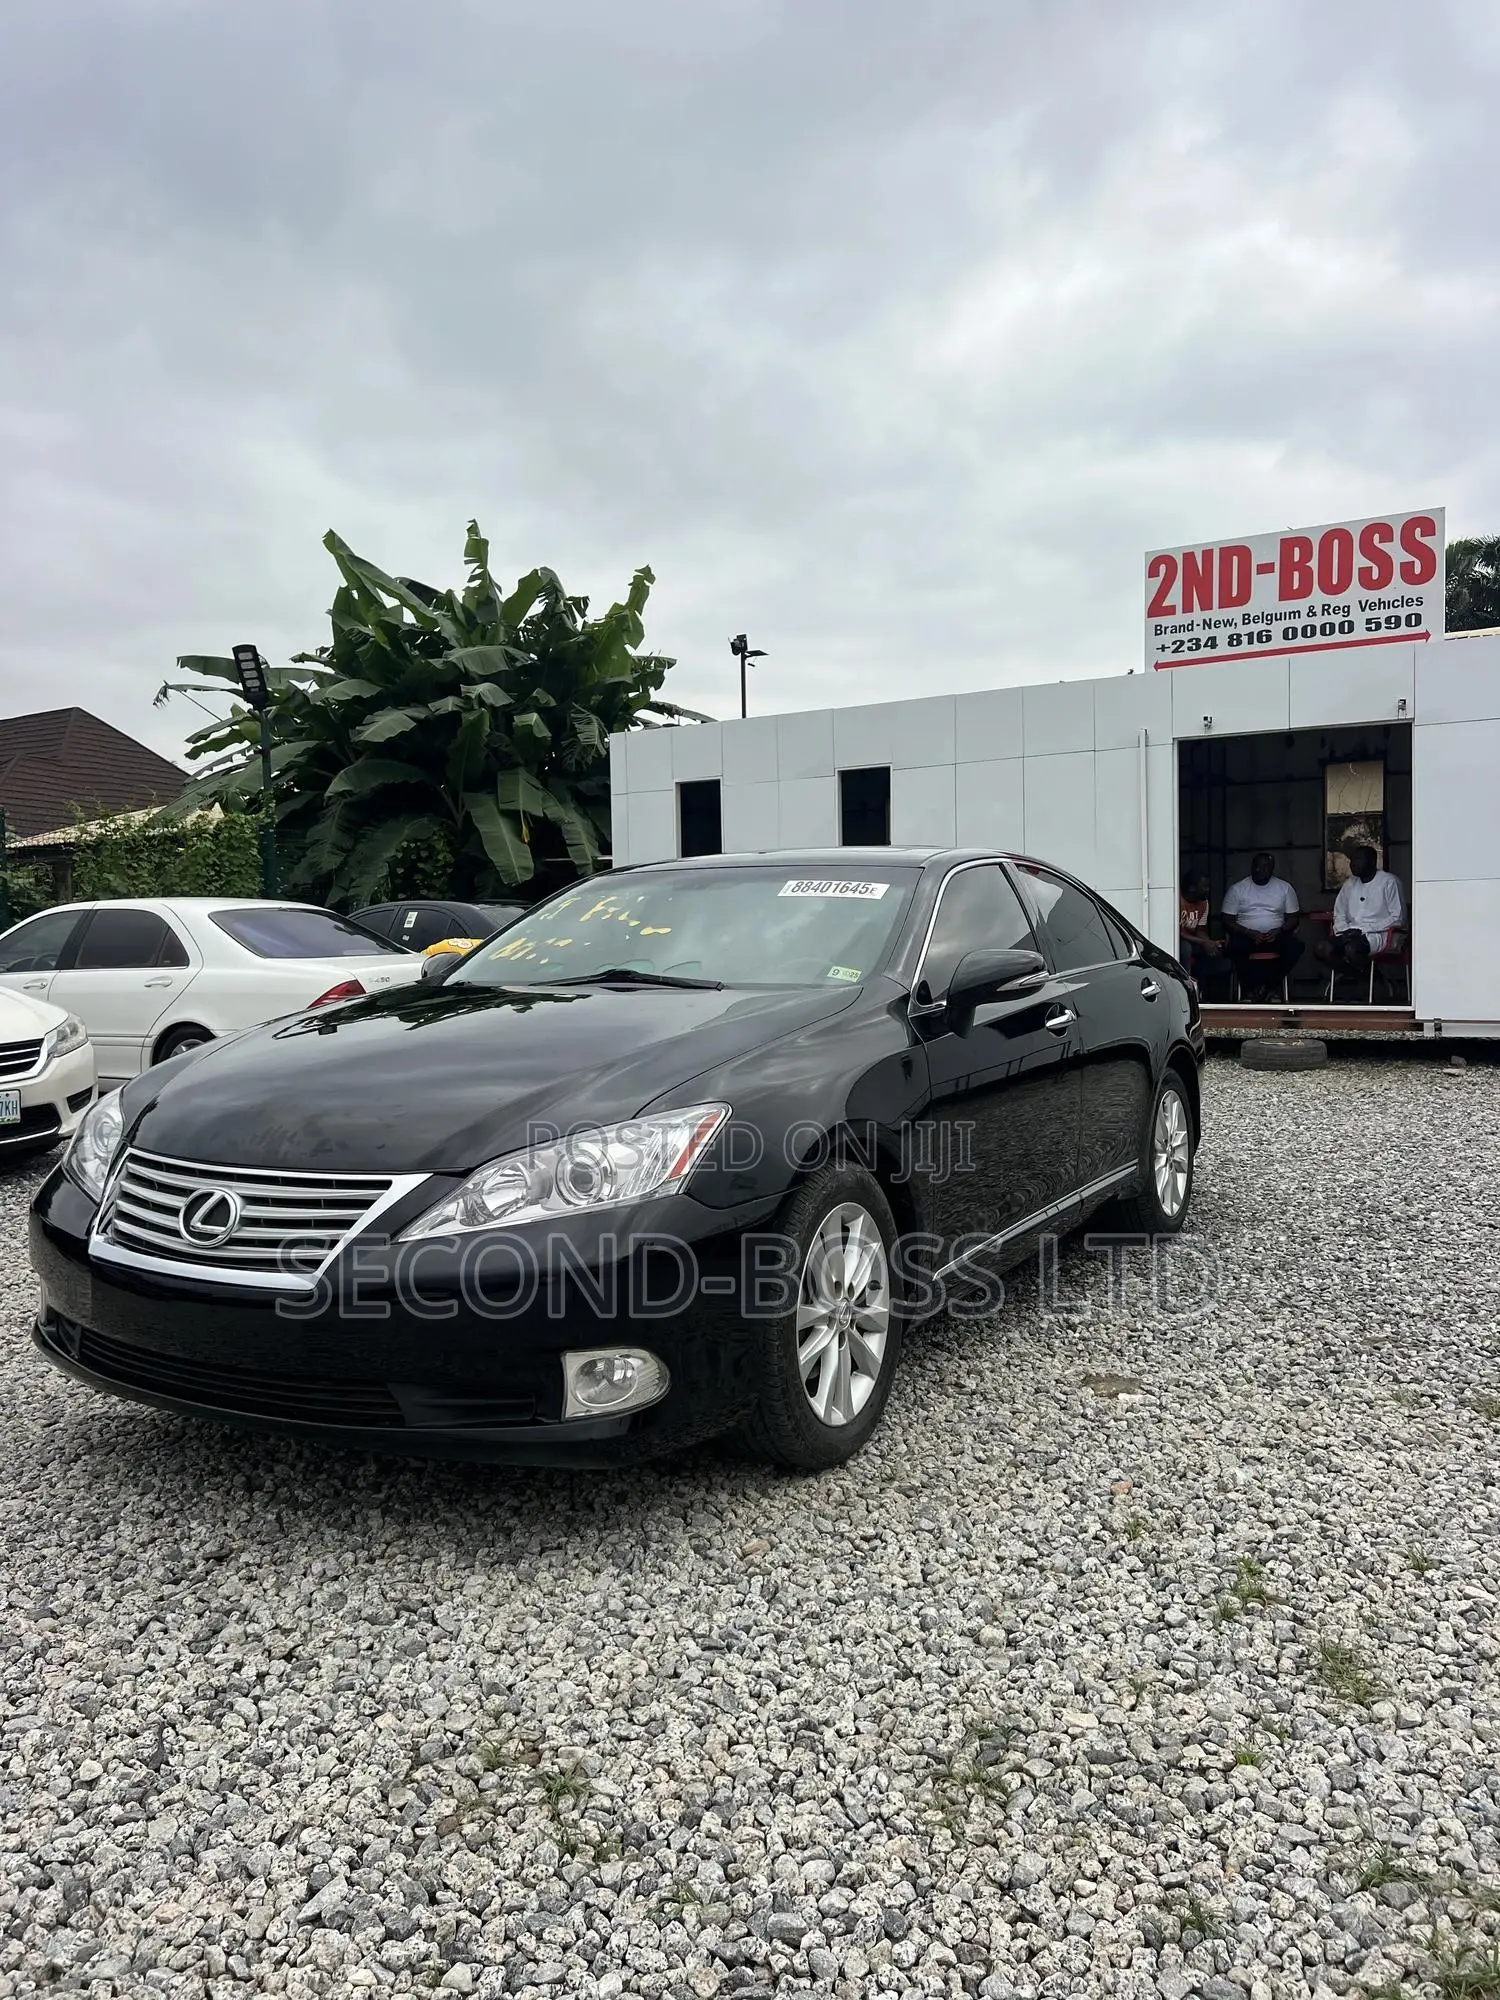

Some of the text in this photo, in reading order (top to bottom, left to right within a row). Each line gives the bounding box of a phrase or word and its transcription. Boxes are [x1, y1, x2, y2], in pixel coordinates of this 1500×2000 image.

[1147, 516, 1437, 618] 2ND-BOSS
[1306, 605, 1317, 618] &
[1321, 604, 1351, 618] Reg
[1358, 595, 1424, 612] Vehicles
[1156, 613, 1422, 653] +234 816 0000 590
